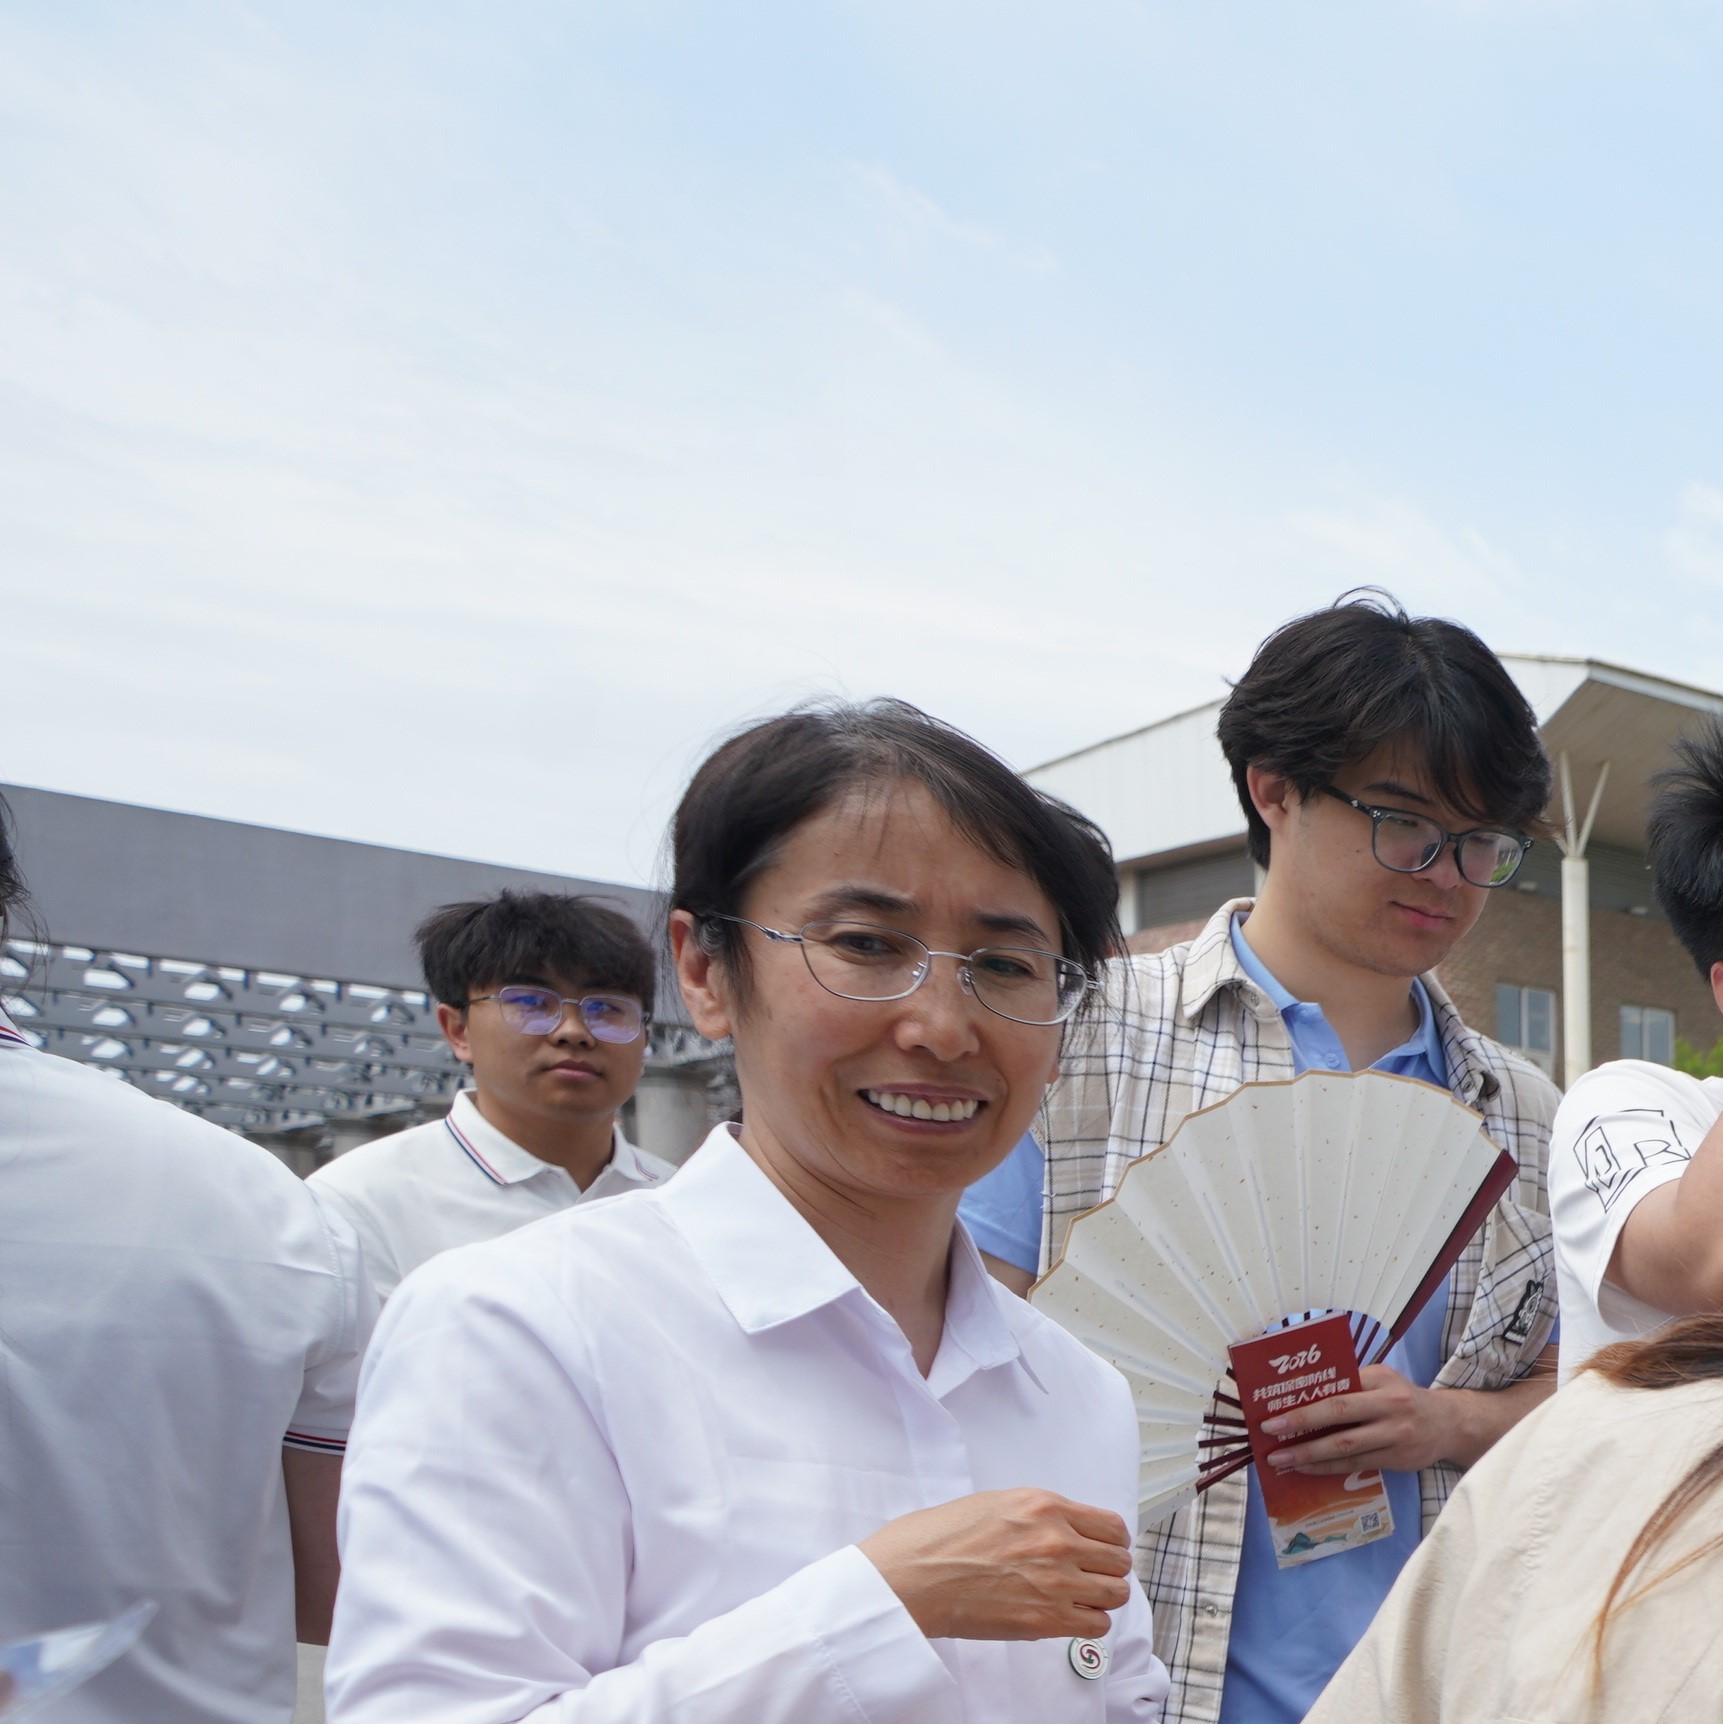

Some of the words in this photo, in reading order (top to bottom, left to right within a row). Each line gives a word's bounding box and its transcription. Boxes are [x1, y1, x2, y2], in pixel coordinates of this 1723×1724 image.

[1268, 1343, 1322, 1374] 2026
[1252, 1366, 1337, 1402] 共筑保密防线
[1267, 1378, 1351, 1412] 师生人人有责
